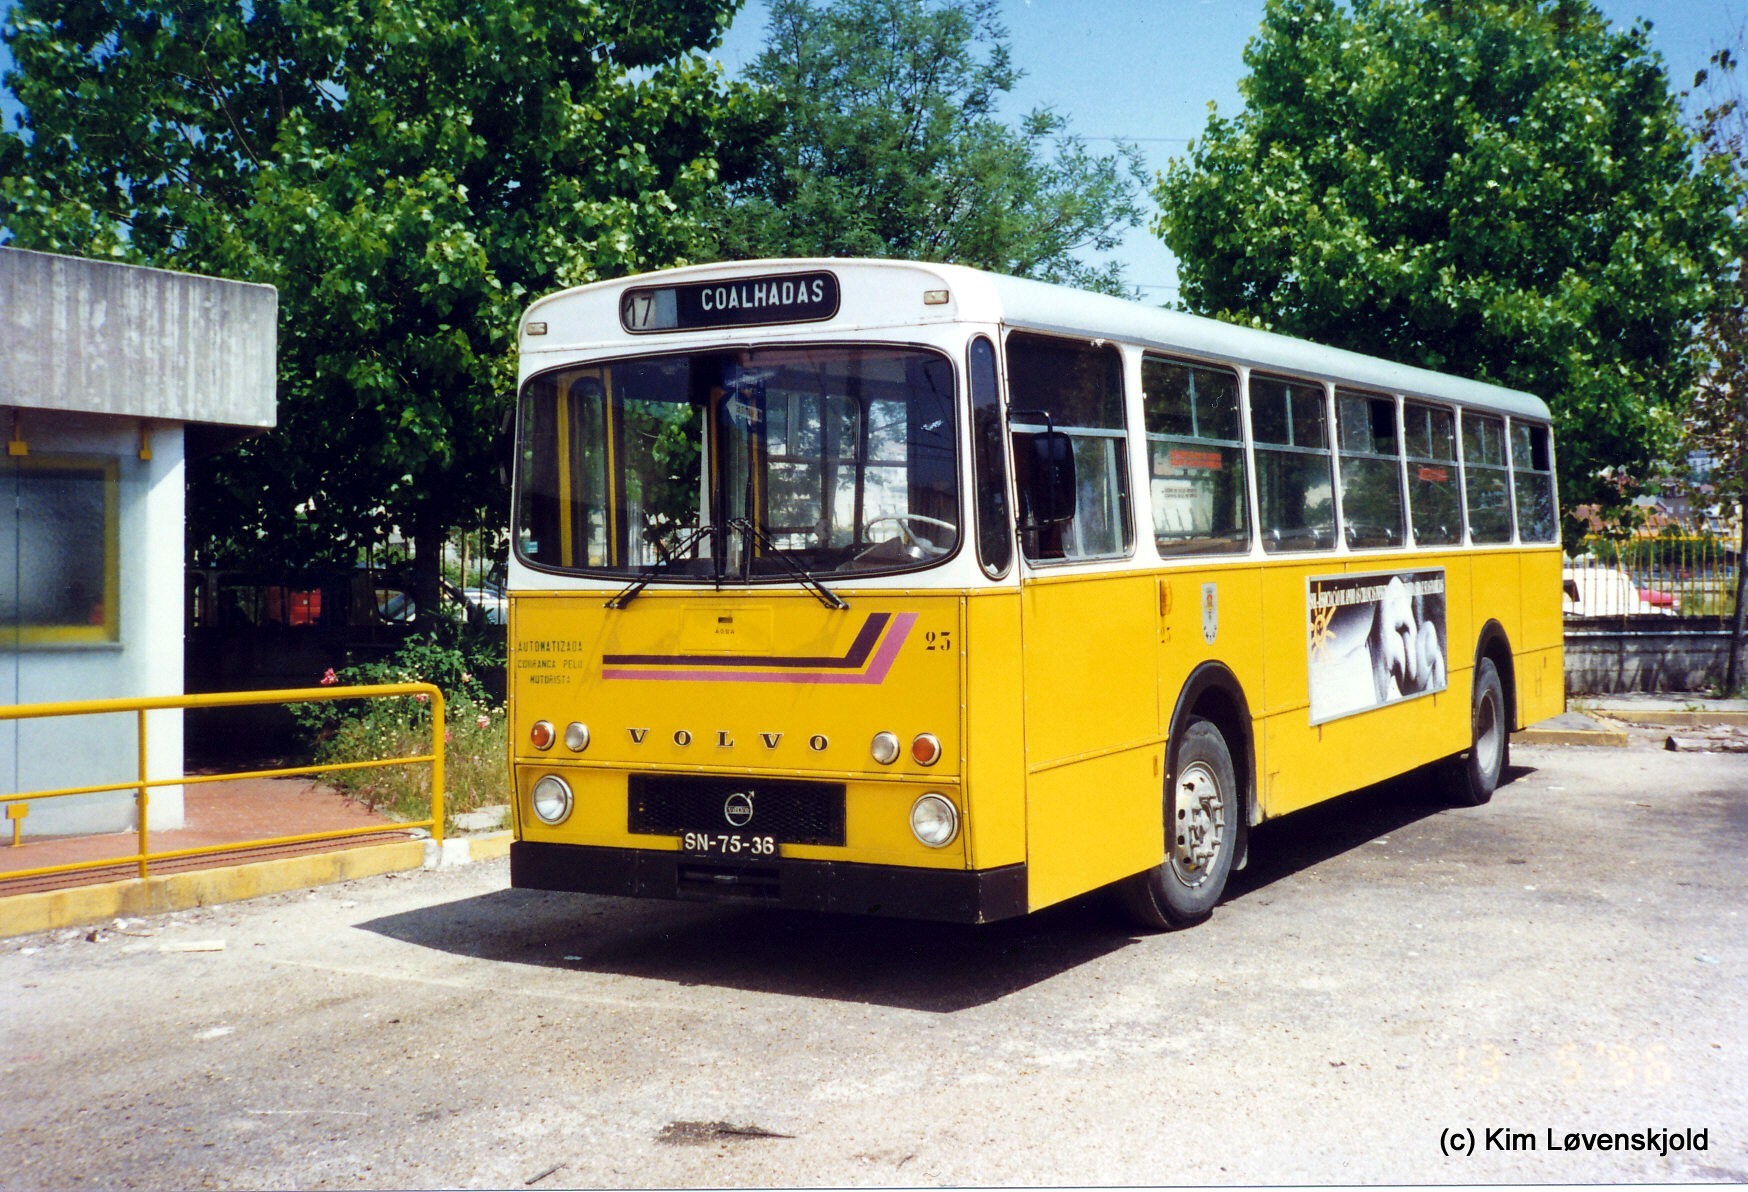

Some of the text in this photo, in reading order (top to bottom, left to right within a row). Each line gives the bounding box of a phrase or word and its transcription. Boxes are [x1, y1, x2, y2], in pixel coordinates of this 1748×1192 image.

[626, 279, 824, 327] 17 COALHADAS
[518, 640, 583, 653] AUTOMATIZADA
[627, 728, 829, 751] VOLVO
[684, 832, 775, 855] SN-75-36
